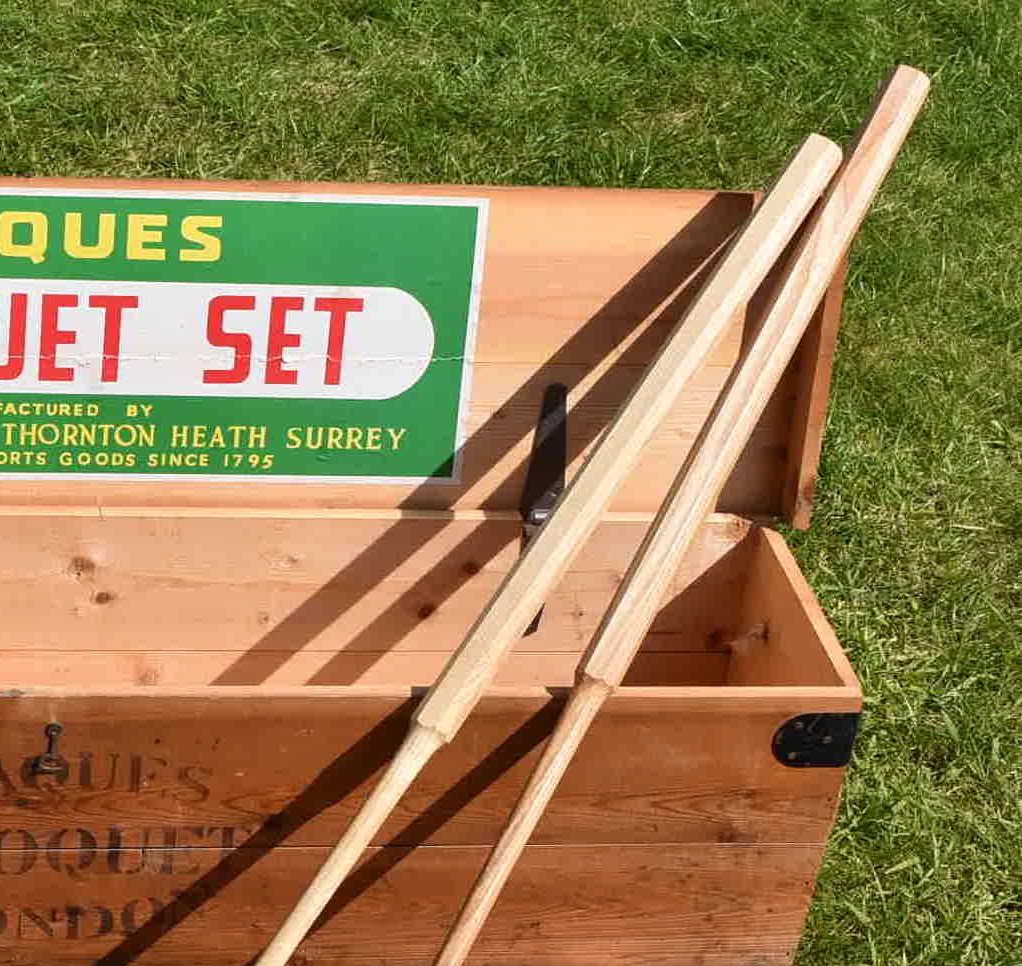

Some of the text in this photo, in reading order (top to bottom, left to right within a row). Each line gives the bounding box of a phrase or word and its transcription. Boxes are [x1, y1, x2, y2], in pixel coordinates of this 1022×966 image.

[203, 294, 365, 386] SET
[126, 403, 154, 418] BY
[2, 423, 157, 448] THORNTON
[170, 425, 268, 449] HEATH
[285, 426, 407, 451] SURREY
[59, 452, 137, 467] GOODS
[147, 453, 211, 468] SINCE
[223, 454, 275, 470] 1795
